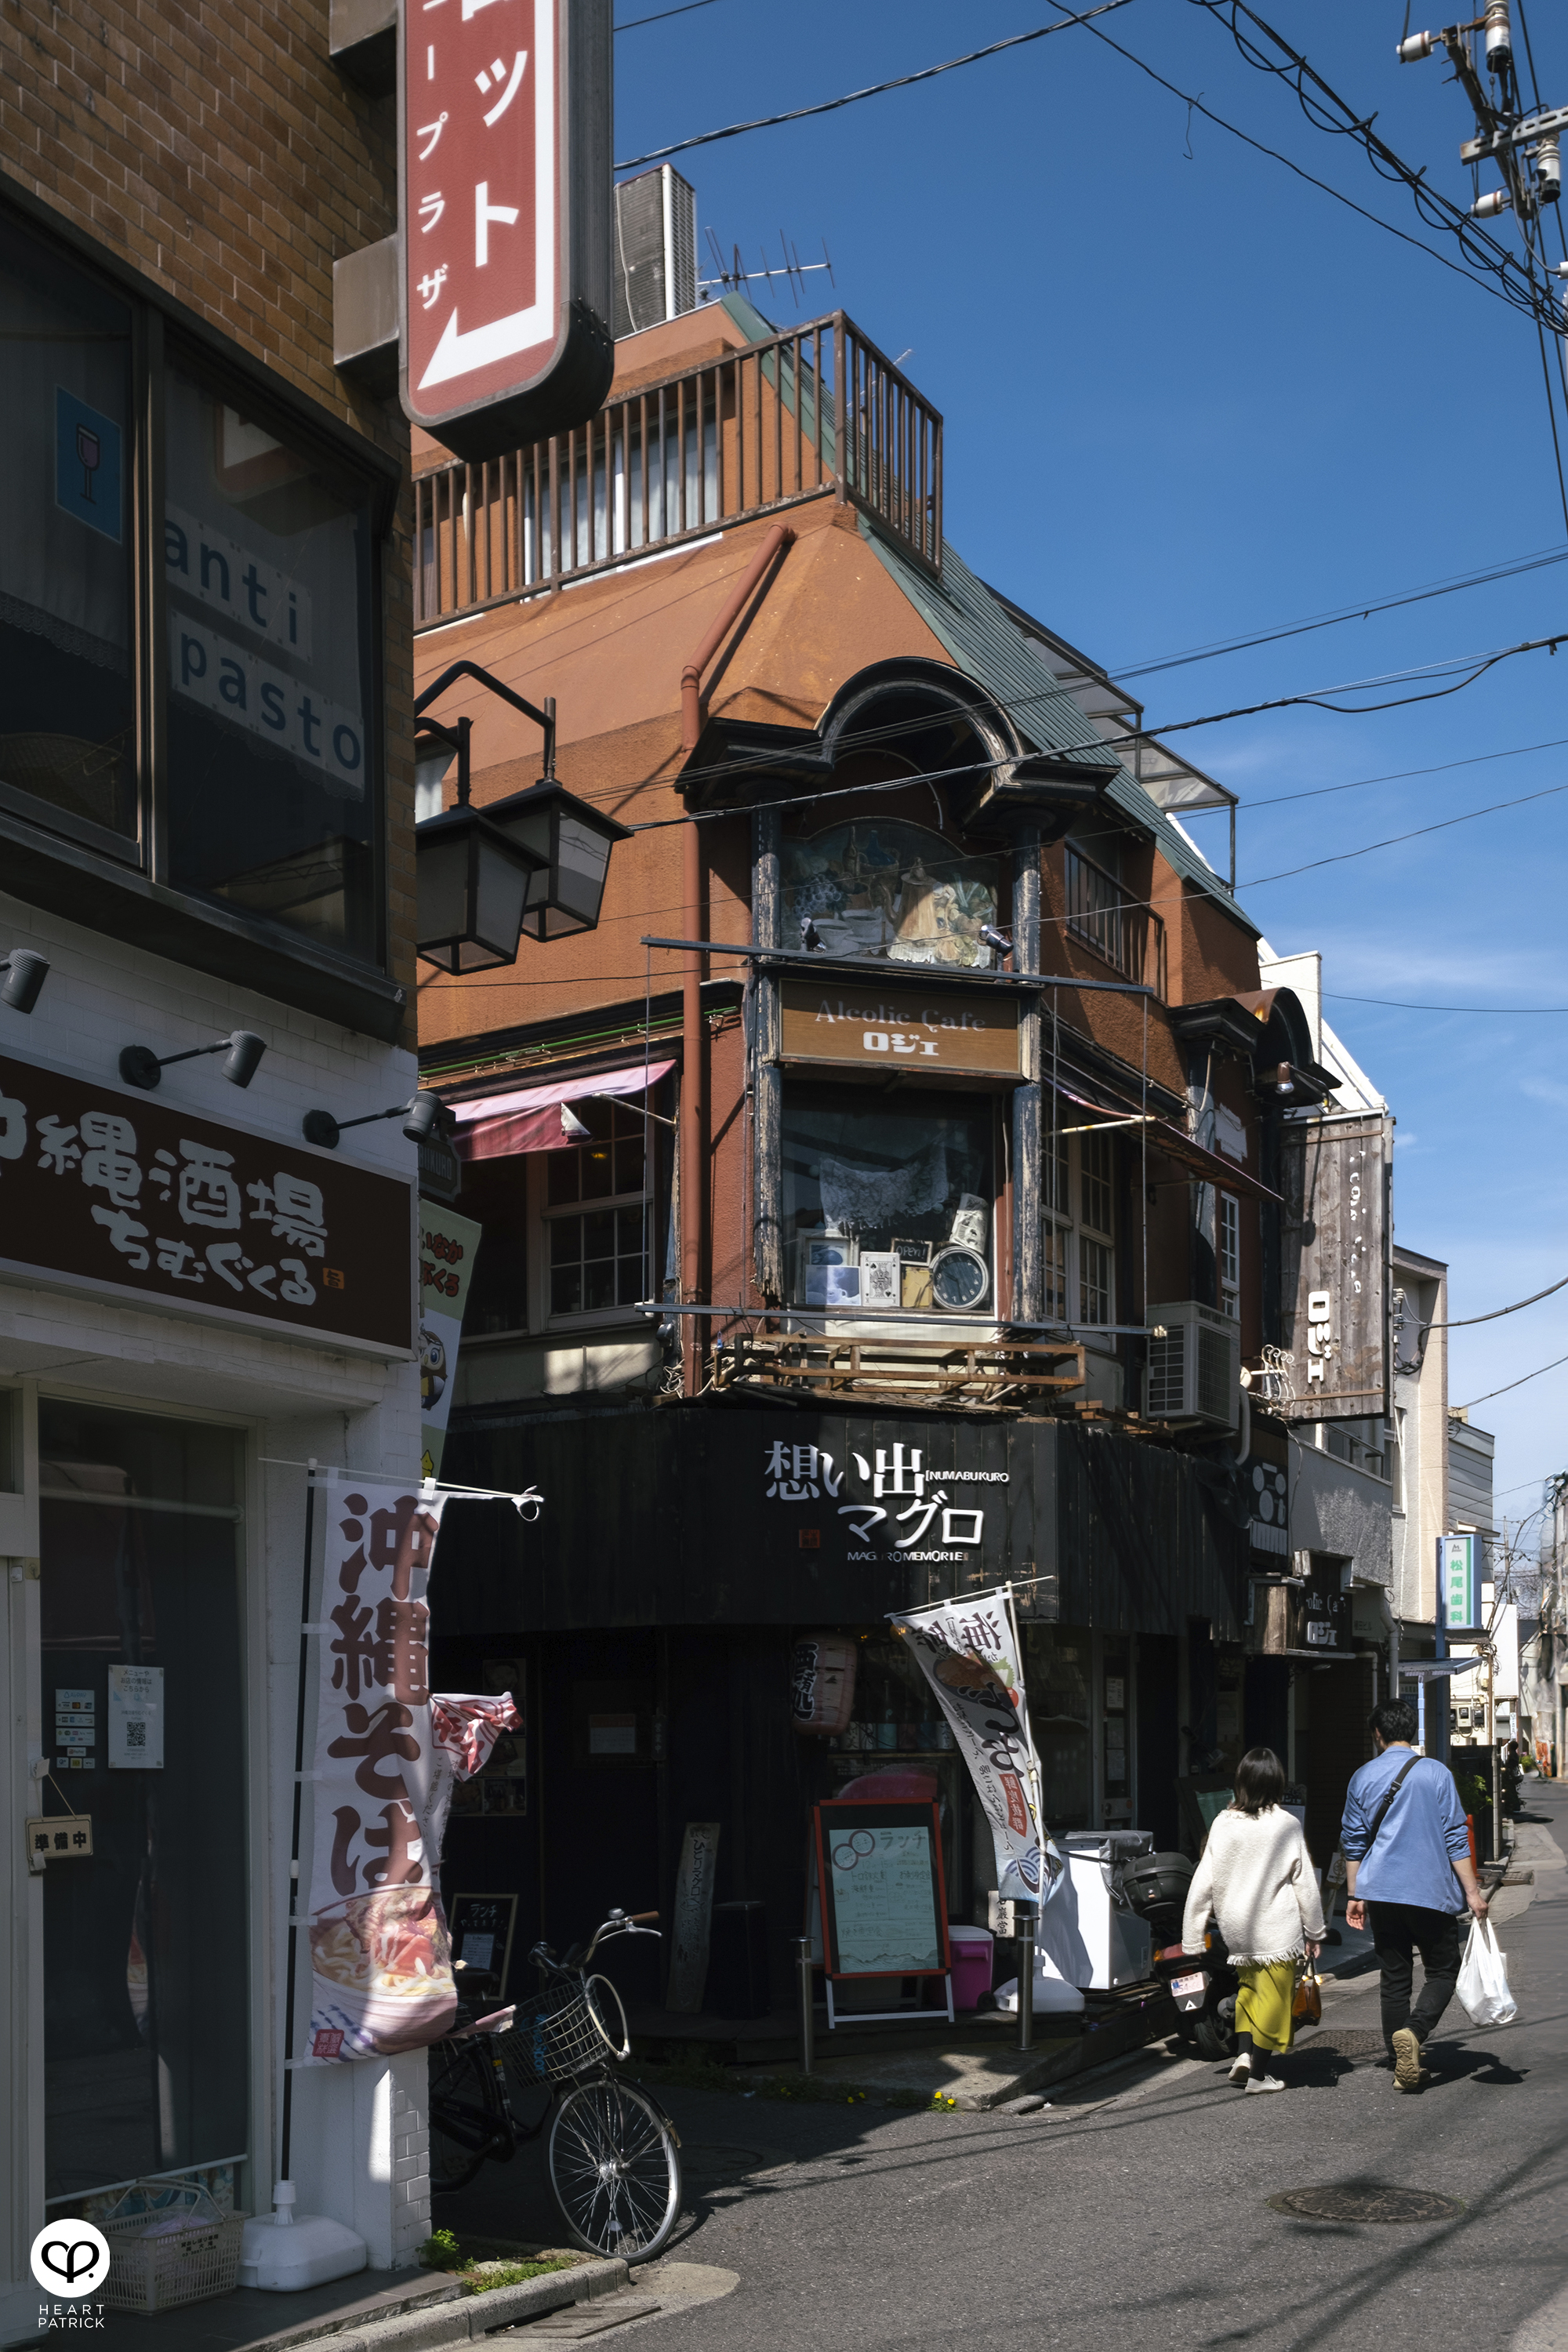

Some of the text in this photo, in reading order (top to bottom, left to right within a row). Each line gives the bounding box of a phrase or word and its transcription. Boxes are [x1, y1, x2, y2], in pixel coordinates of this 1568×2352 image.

[462, 0, 528, 267] ット
[165, 516, 299, 644] anti
[181, 630, 361, 771] pasto
[815, 999, 985, 1033] Alcolic Cafe
[91, 1205, 316, 1306] ちむぐくる
[764, 1440, 925, 1501] 想い出
[837, 1490, 984, 1548] マグロ
[1450, 1559, 1463, 1622] 松尾歯科
[34, 1831, 88, 1852] 準備中
[880, 1830, 926, 1850] ランチ
[470, 1904, 497, 1918] ランチ
